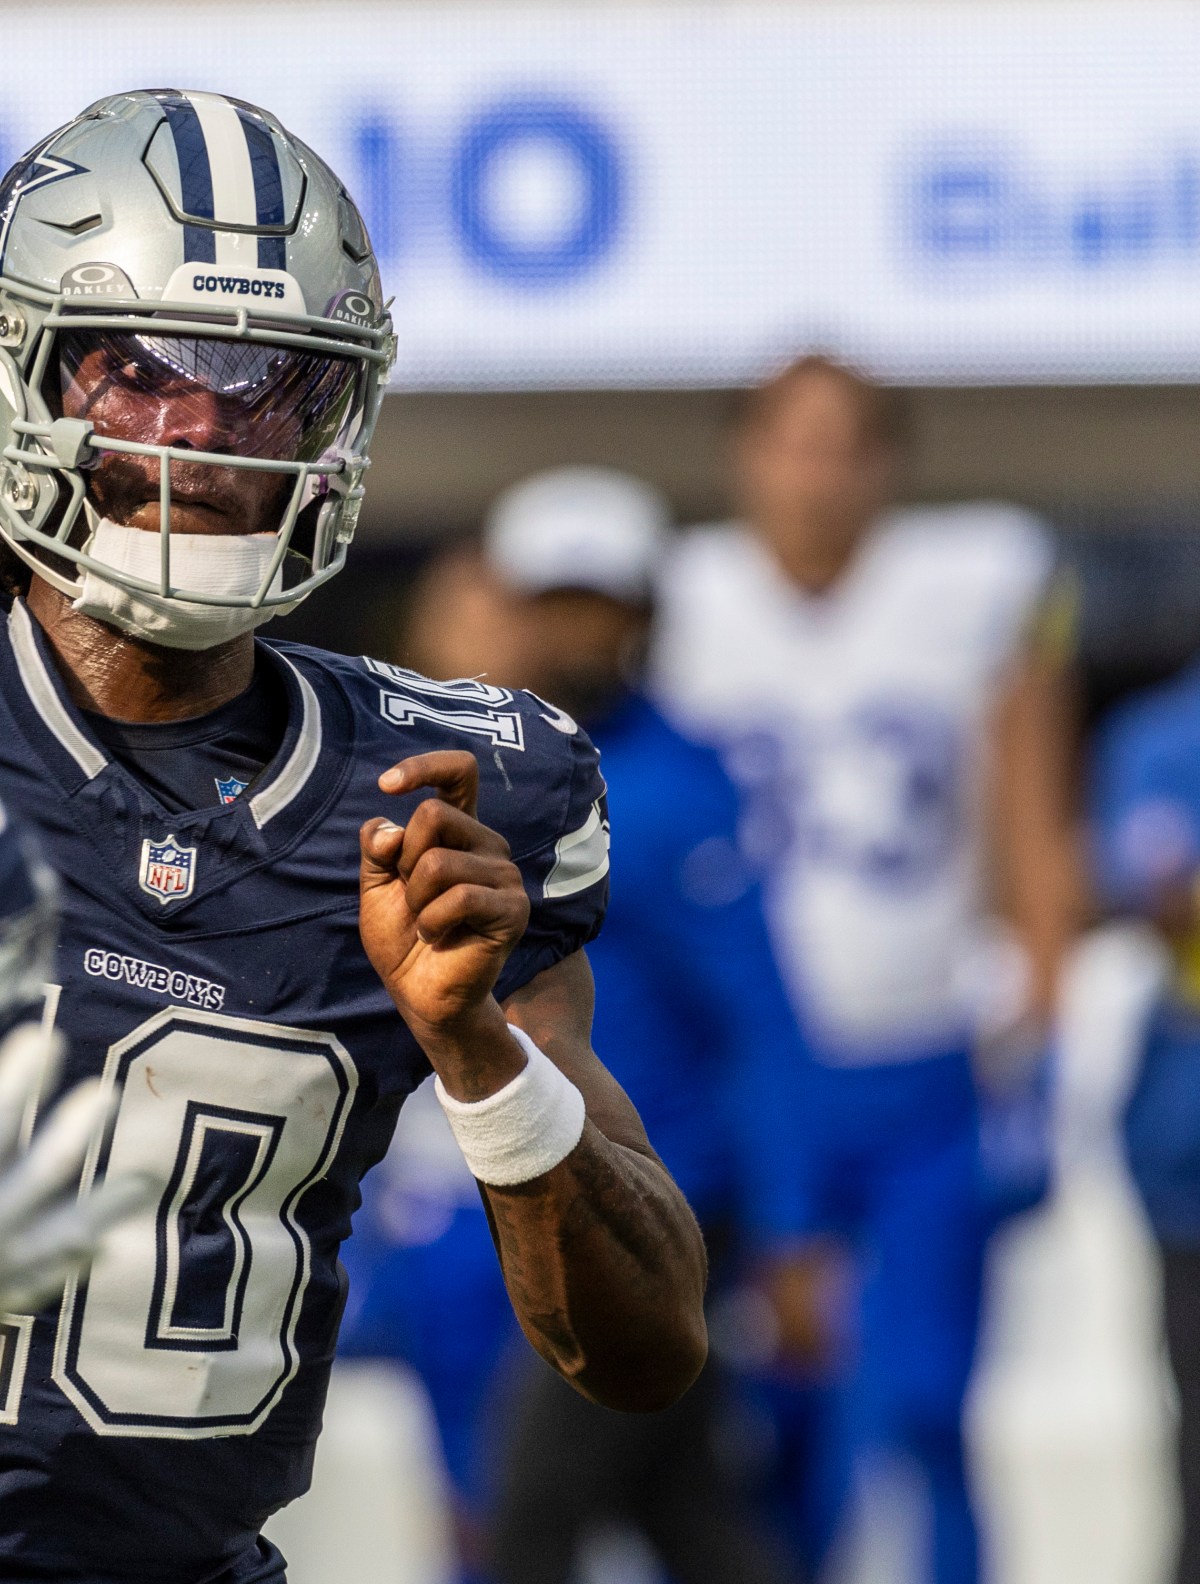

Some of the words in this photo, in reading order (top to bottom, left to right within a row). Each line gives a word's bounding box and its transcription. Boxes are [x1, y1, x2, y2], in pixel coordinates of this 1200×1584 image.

[62, 284, 125, 297] OAKLEY
[193, 274, 285, 299] COWBOYS
[148, 863, 187, 893] NFL
[84, 948, 226, 1011] COWBOYS
